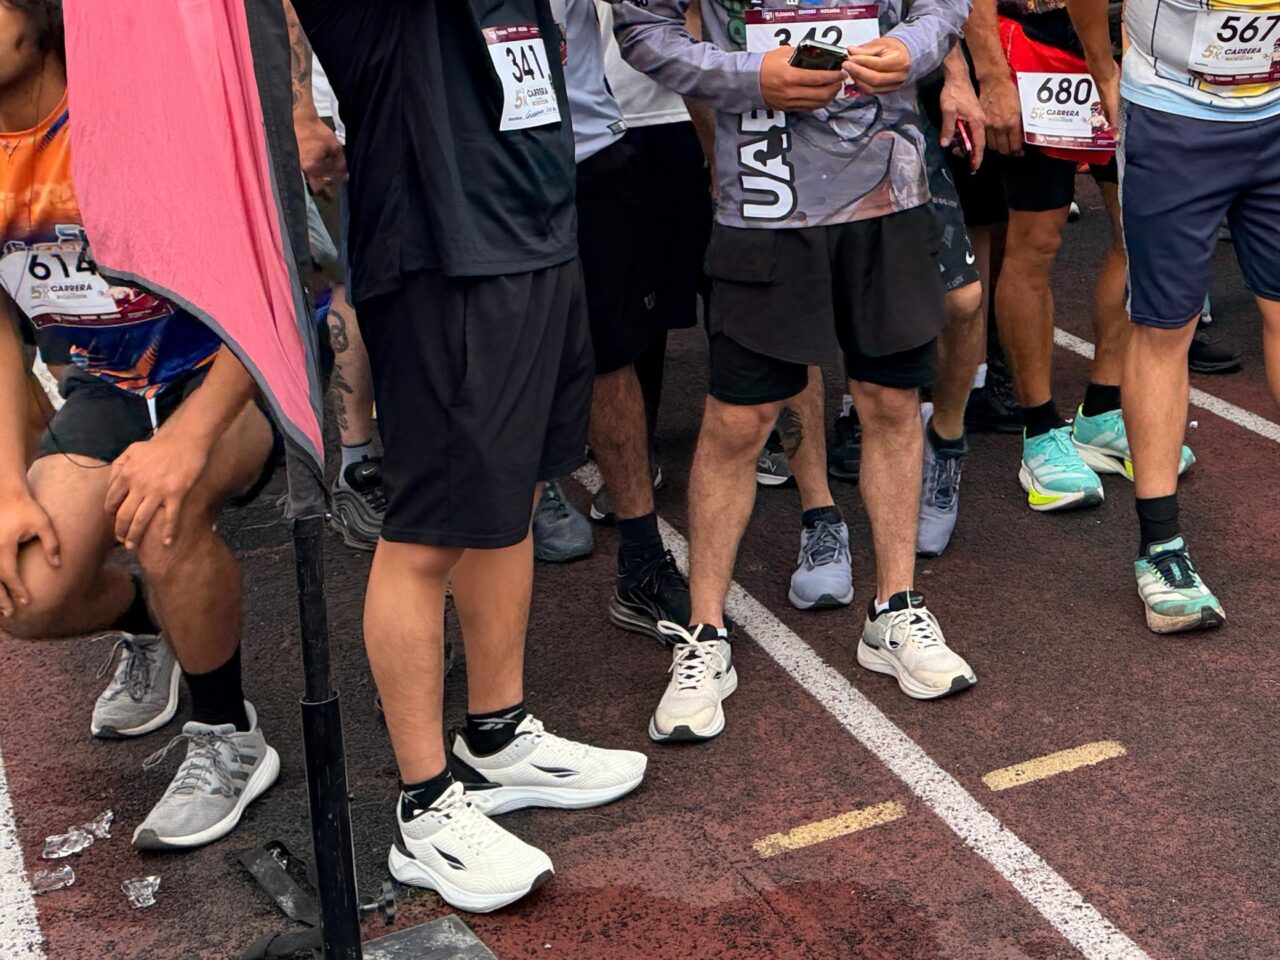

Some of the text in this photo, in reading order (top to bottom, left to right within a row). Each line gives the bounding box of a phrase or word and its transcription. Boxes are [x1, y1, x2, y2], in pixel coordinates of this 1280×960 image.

[506, 45, 544, 83] 341
[1037, 77, 1093, 105] 680
[28, 239, 98, 281] 614
[51, 283, 93, 292] CARRERA
